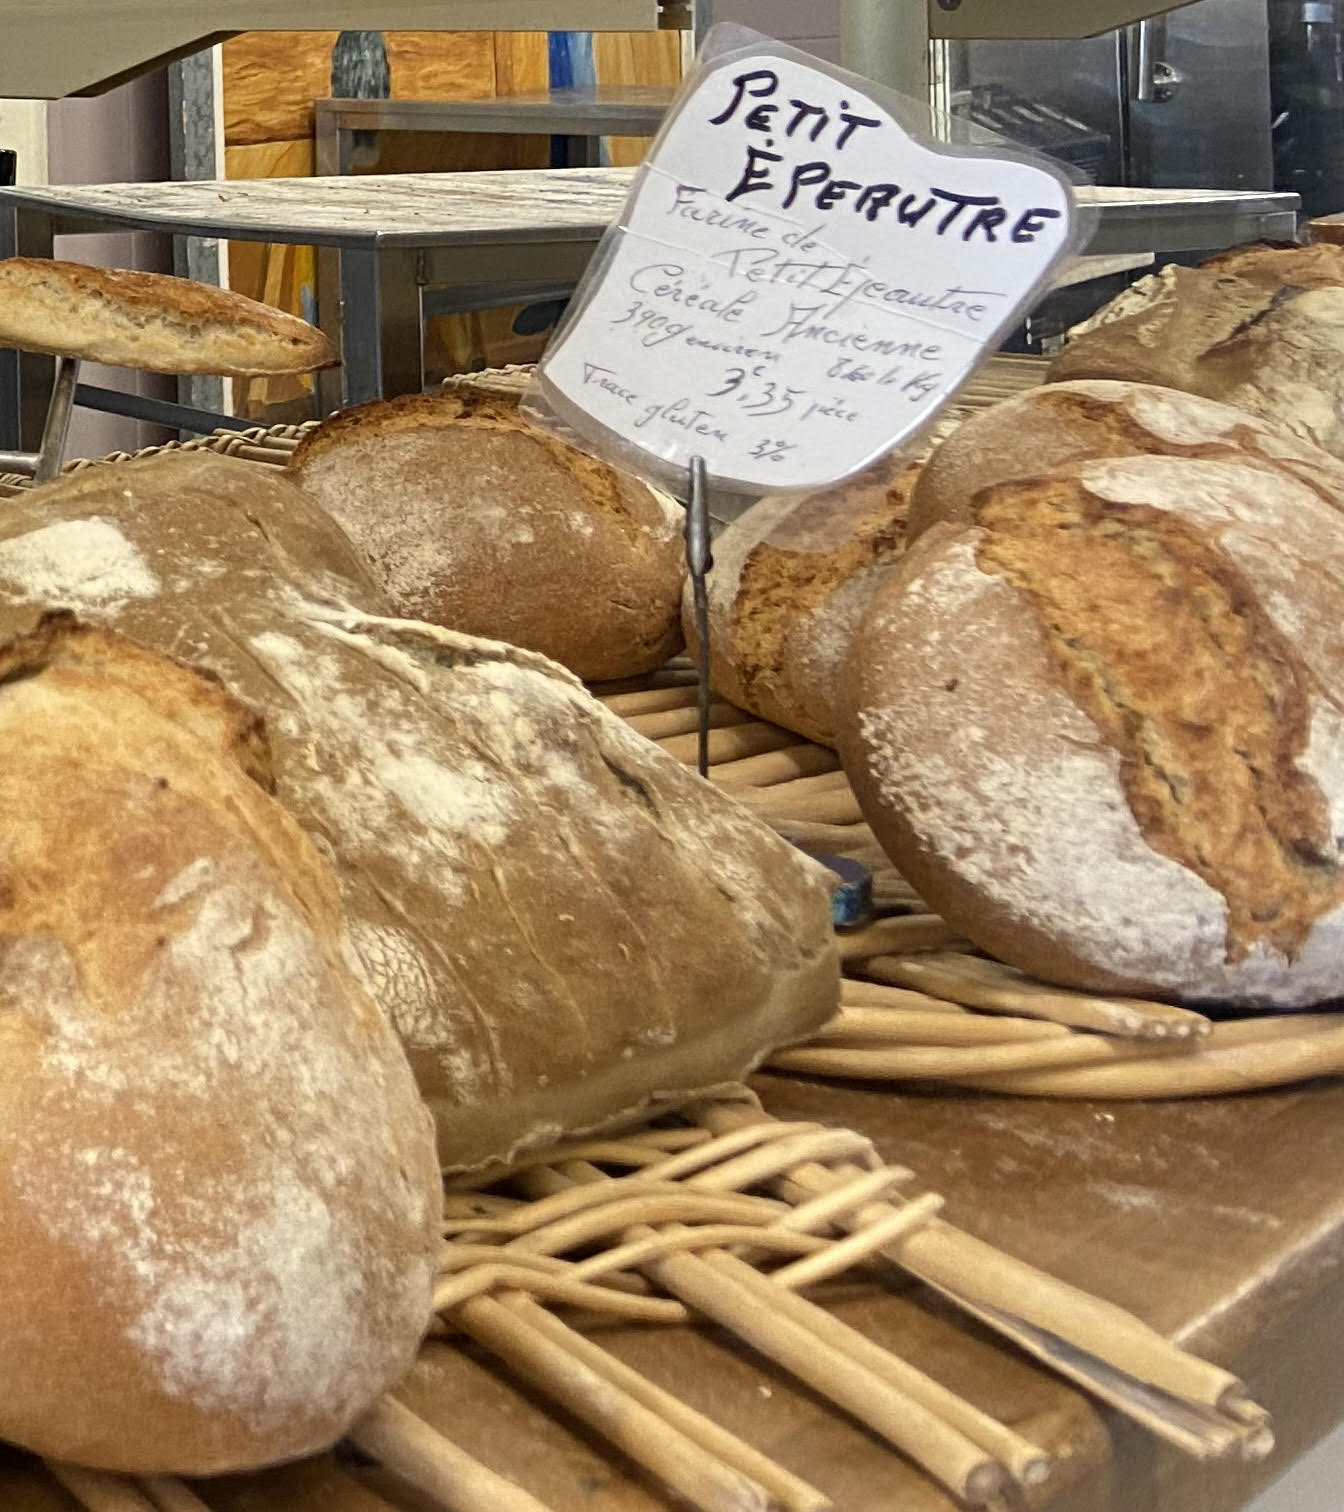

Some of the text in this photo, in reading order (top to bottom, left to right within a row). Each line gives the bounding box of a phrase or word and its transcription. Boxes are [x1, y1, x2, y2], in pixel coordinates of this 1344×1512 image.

[666, 184, 826, 253] Farine de
[712, 247, 848, 289] Petit
[764, 302, 944, 363] Ancienne
